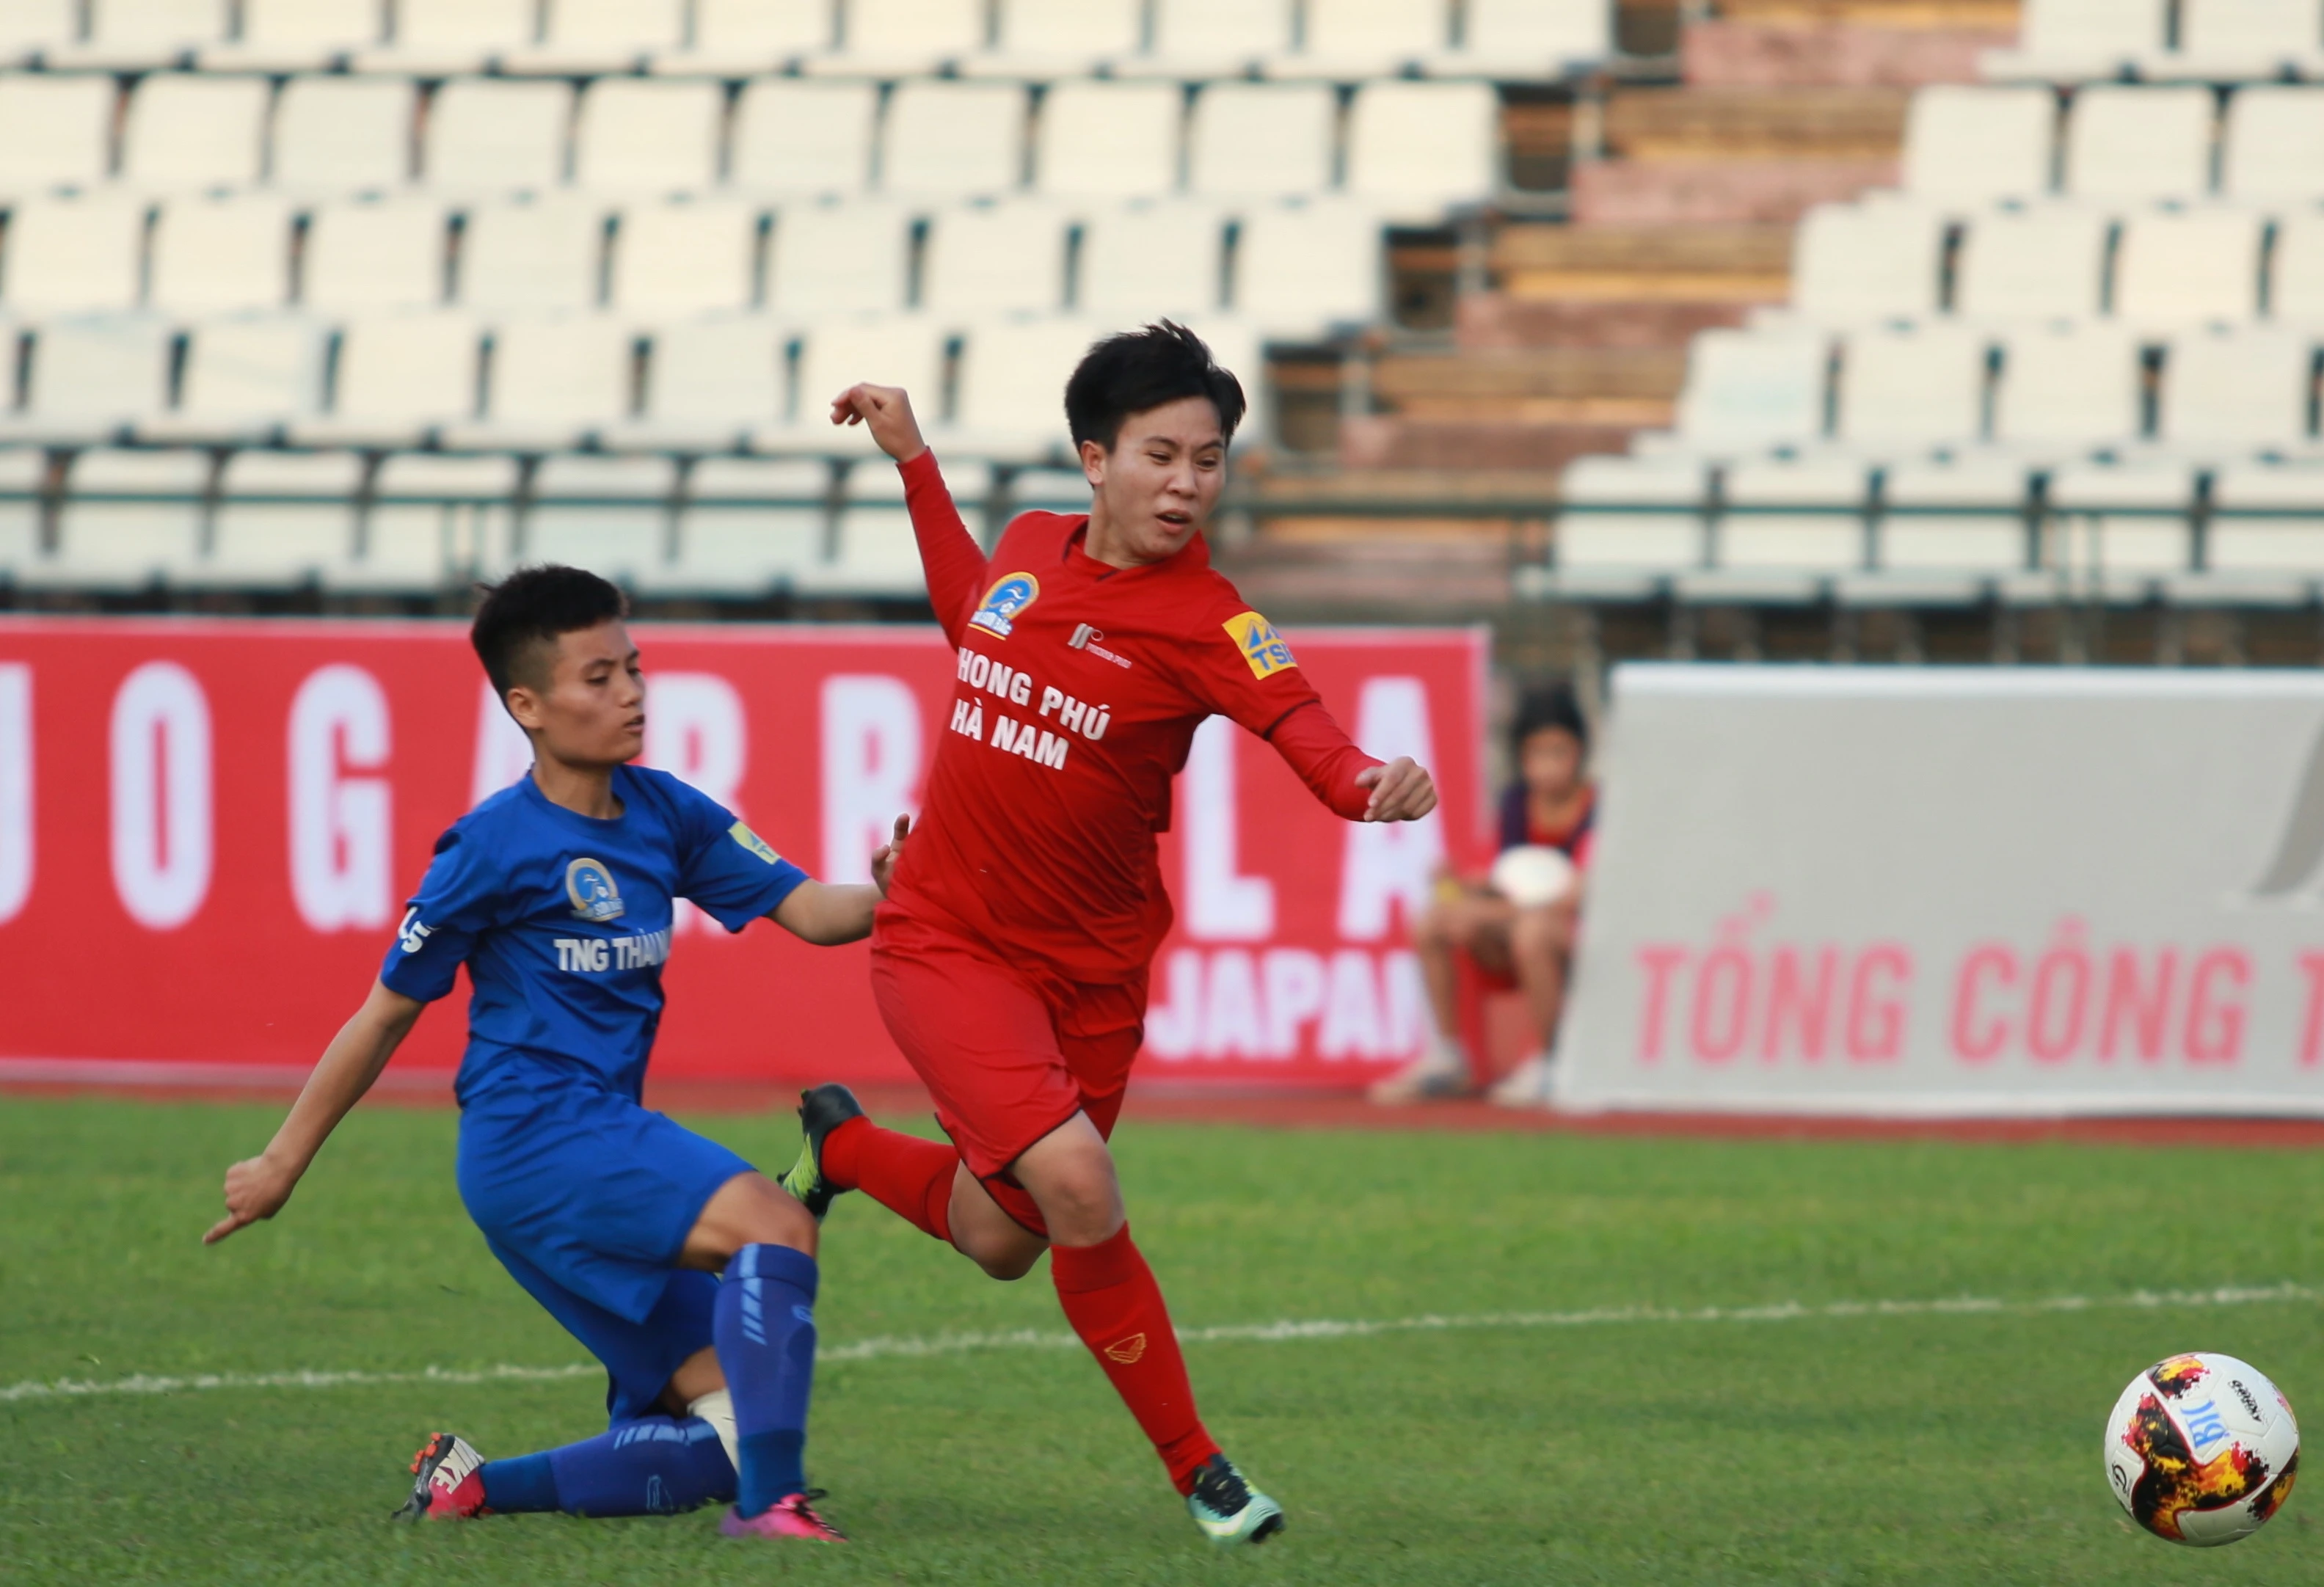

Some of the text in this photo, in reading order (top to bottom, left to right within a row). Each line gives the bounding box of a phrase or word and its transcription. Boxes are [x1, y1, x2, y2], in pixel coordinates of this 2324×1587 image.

[950, 696, 1069, 770] HÀ NAM
[957, 646, 1111, 741] HONG PHÚ
[553, 938, 610, 972] TNG
[1633, 892, 1915, 1065] TỔNG
[1949, 917, 2253, 1068] CÔNG
